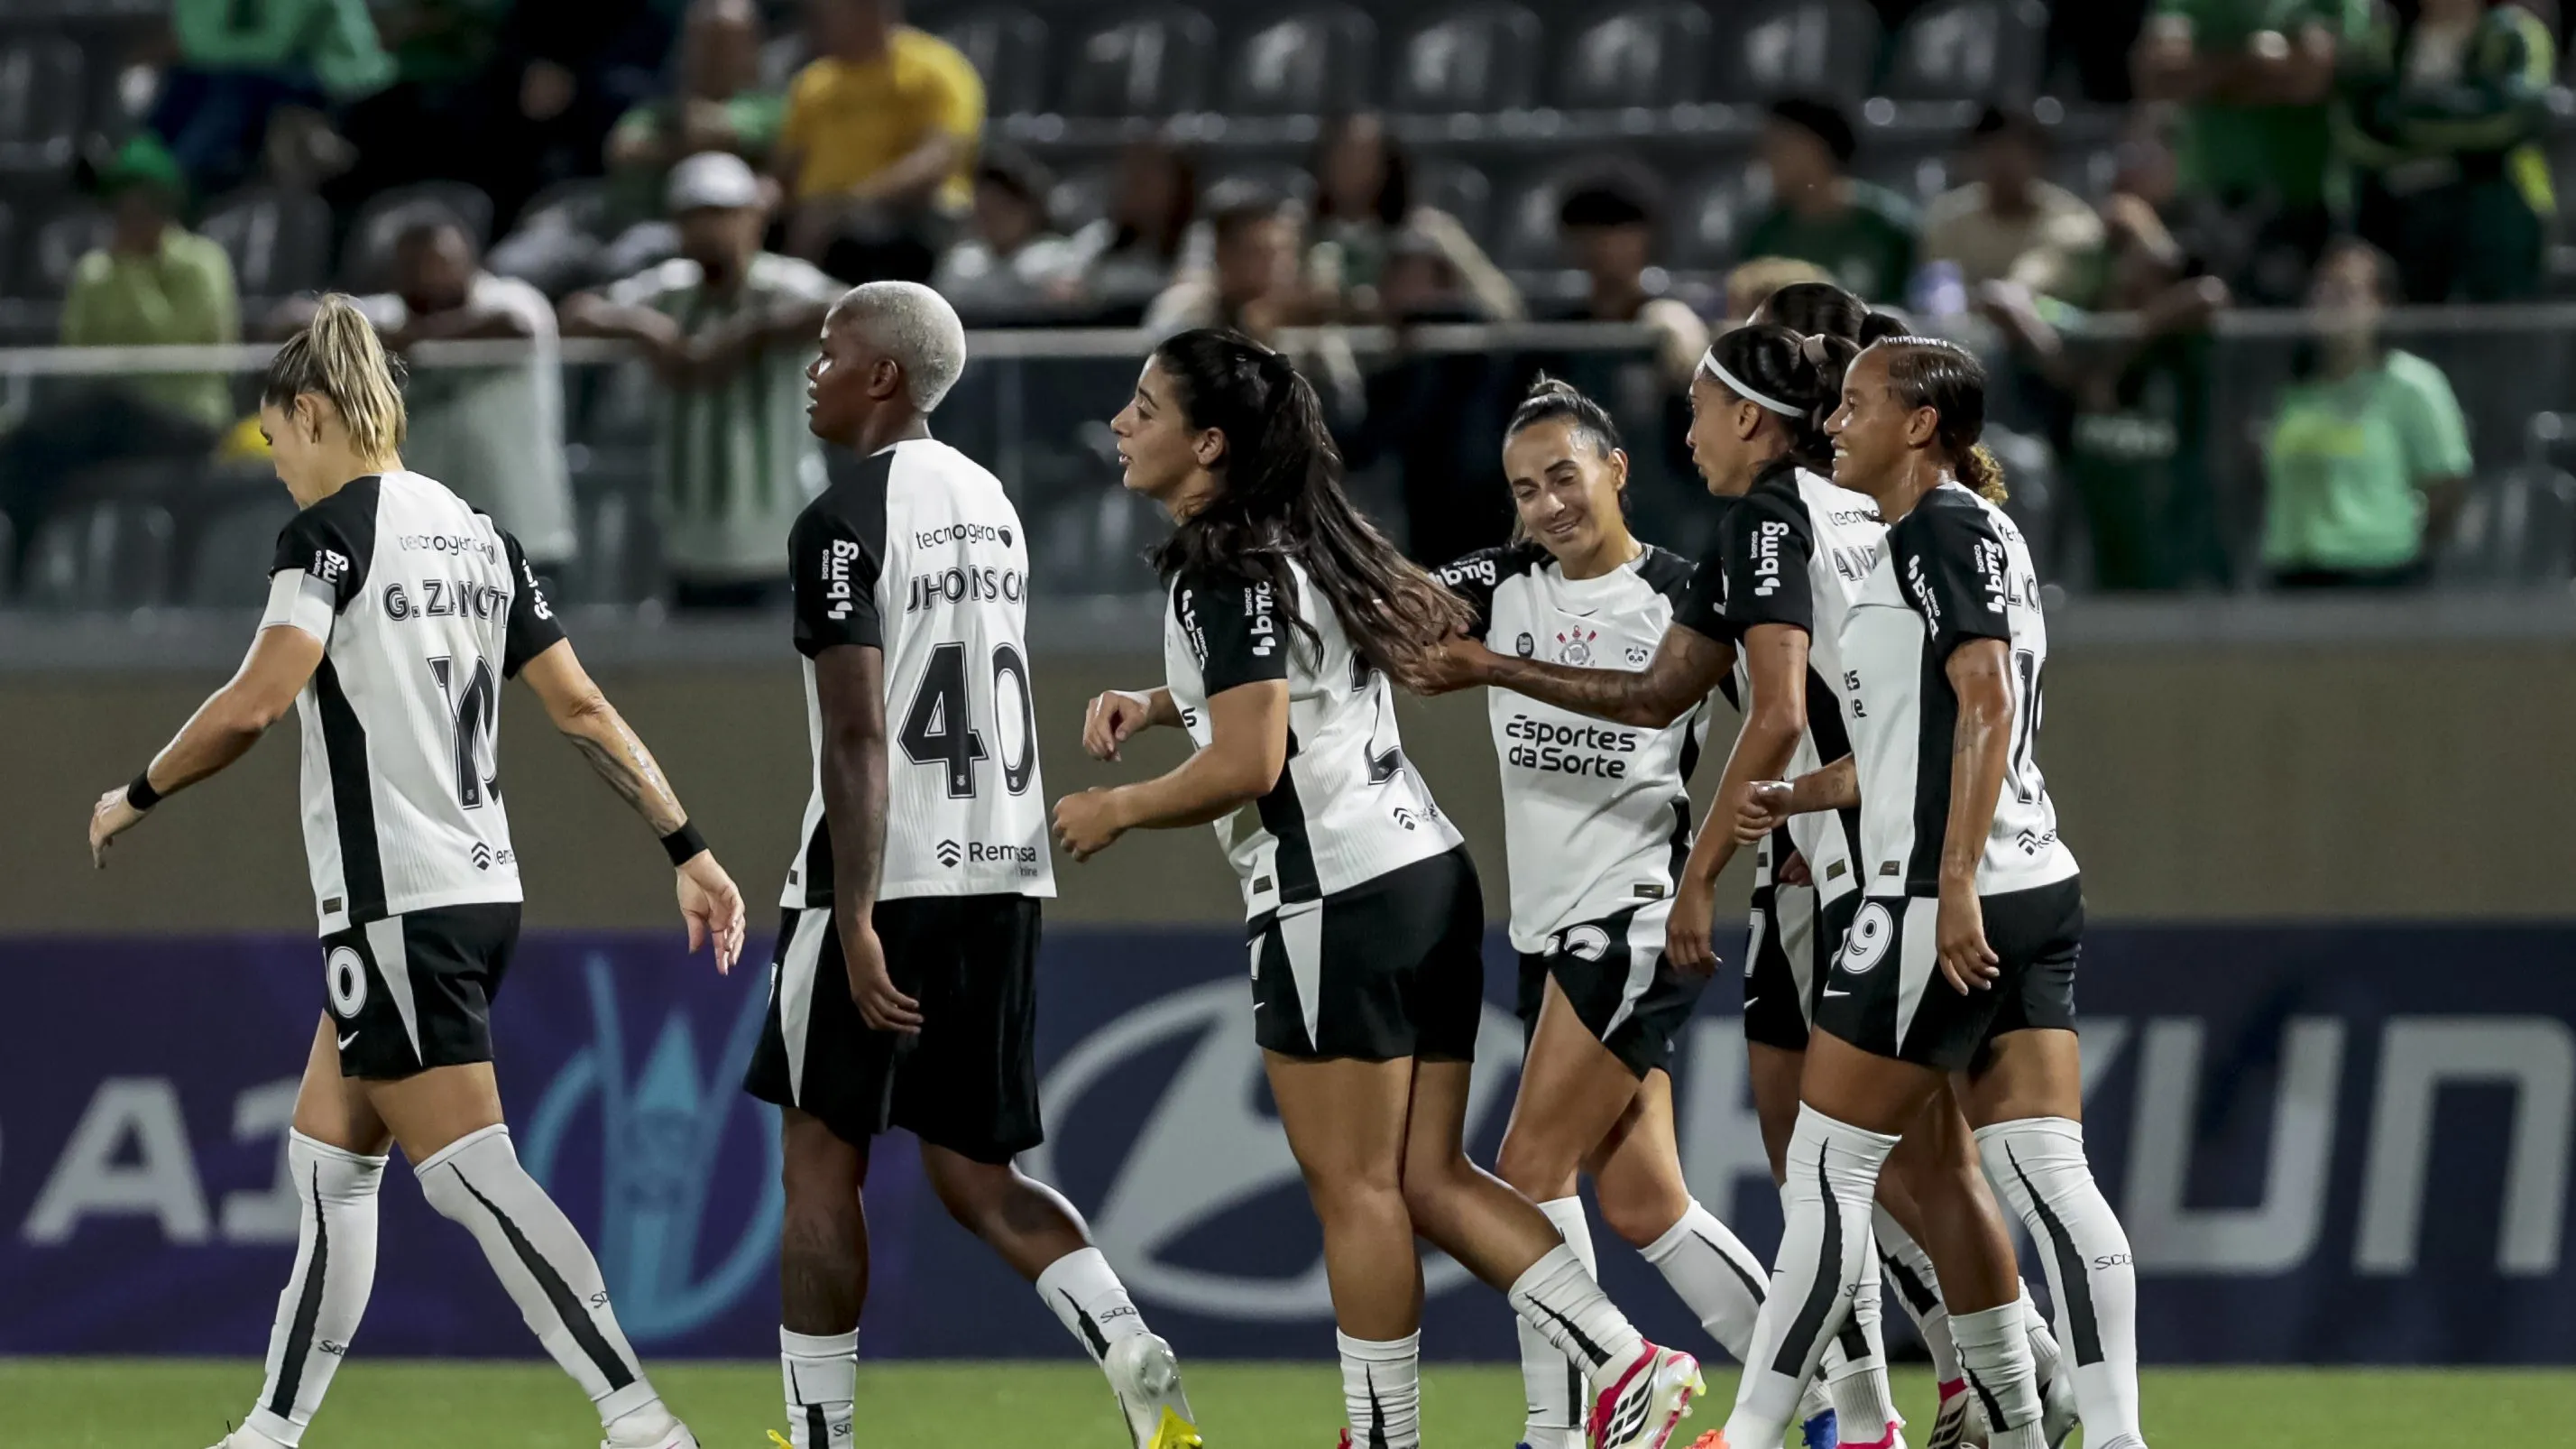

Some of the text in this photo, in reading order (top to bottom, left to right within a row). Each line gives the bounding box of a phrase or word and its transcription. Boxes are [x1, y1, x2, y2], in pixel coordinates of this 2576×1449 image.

[323, 549, 349, 584] mg
[821, 549, 830, 580] banco
[827, 539, 860, 599] bmg
[1440, 559, 1496, 586] bmg
[1755, 521, 1790, 576] bmg
[1983, 537, 2004, 595] bmg
[897, 641, 1036, 799] 40
[1505, 714, 1637, 753] Esportes
[322, 946, 367, 1020] 0
